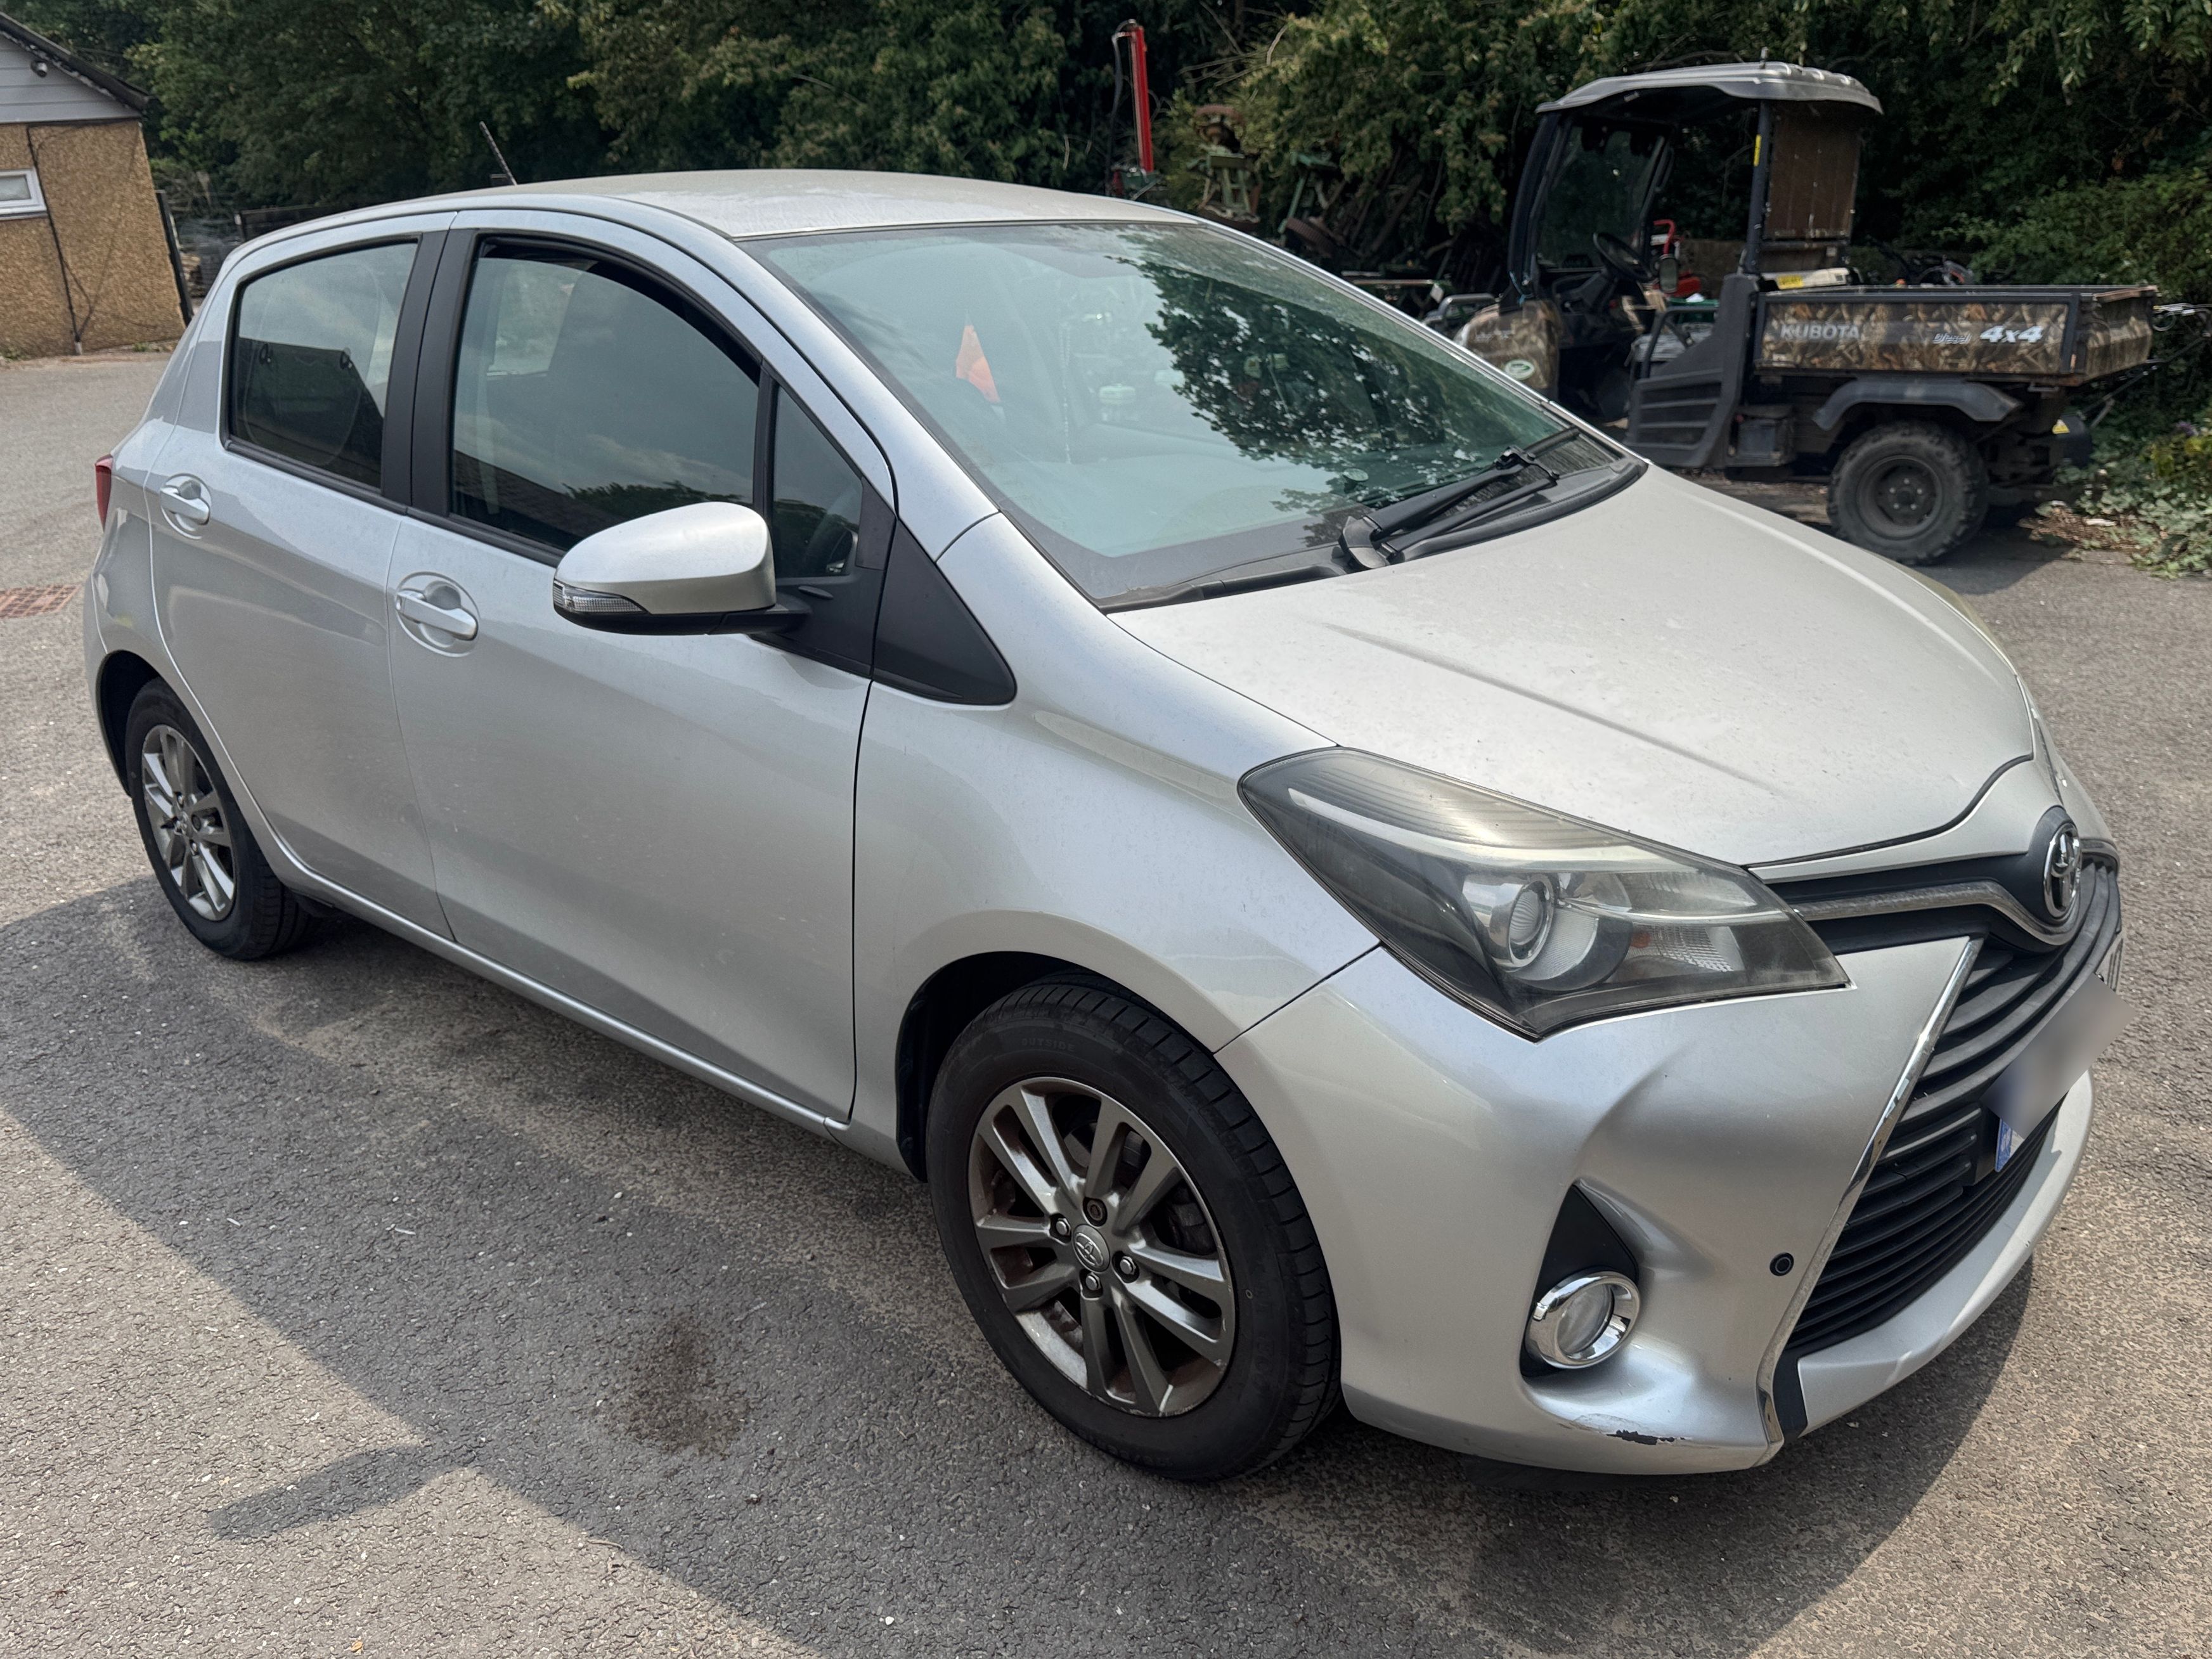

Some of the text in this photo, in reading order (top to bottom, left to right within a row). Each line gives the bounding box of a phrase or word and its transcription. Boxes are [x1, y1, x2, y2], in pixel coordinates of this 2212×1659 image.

[1780, 323, 1860, 340] KUBOTA
[1979, 325, 2043, 343] 4x4
[1021, 1038, 1075, 1052] OUTSIDE
